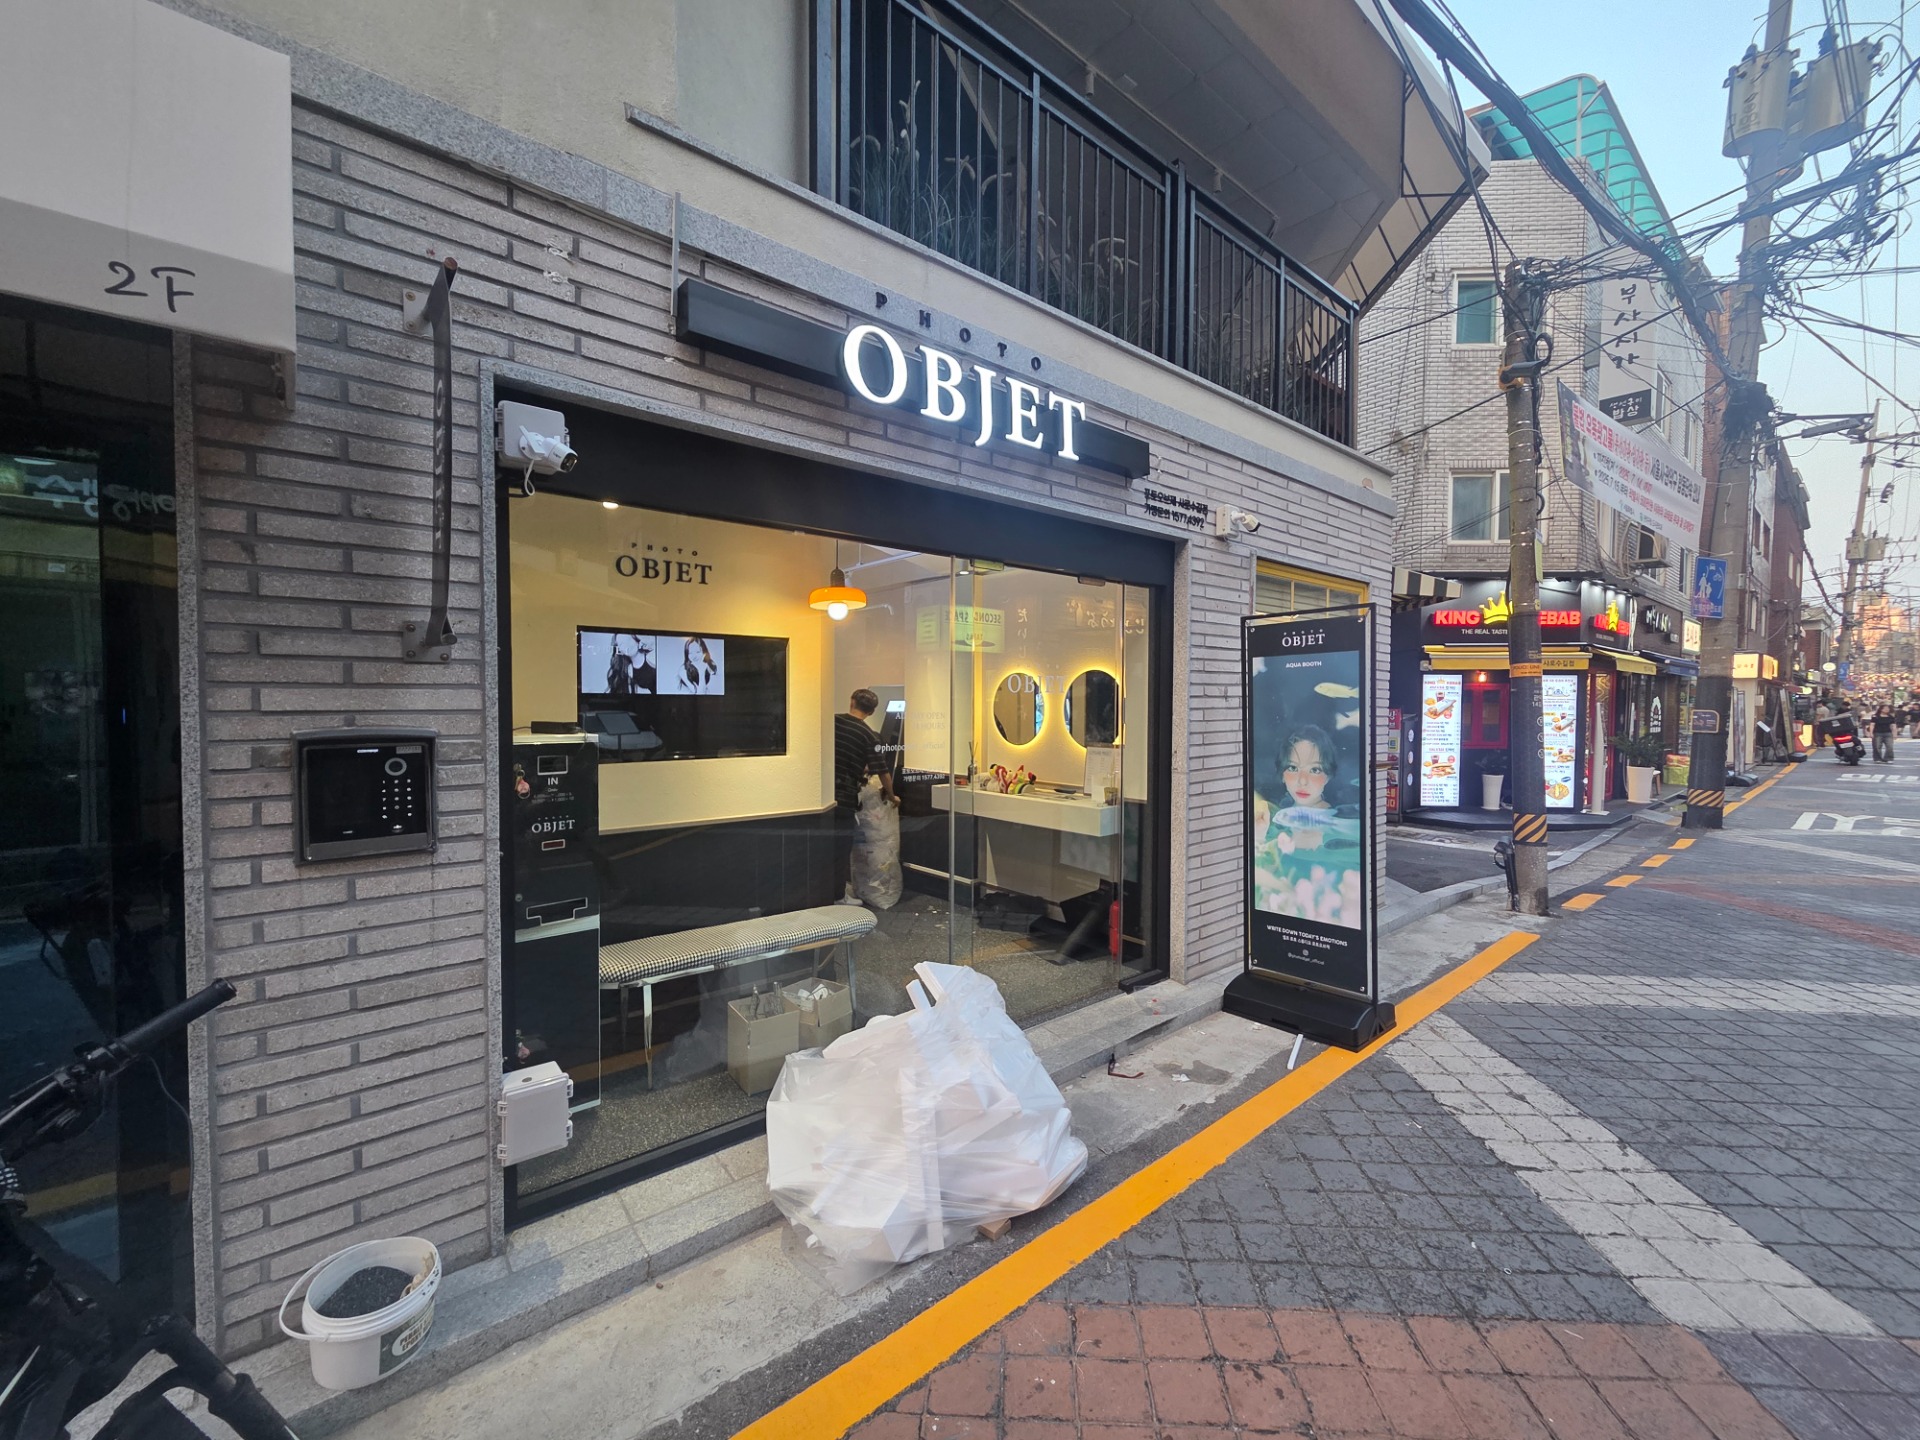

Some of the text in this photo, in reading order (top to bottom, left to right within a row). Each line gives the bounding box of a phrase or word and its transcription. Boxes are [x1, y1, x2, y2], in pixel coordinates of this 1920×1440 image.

[104, 260, 196, 313] 2F
[875, 291, 1042, 371] PHOTO
[843, 323, 1086, 461] OBJET
[1612, 405, 1640, 421] 밥상
[1144, 503, 1170, 519] 가맹문의
[631, 542, 698, 557] PHOTO
[615, 555, 713, 585] OBJET
[1435, 611, 1480, 626] KING
[1538, 610, 1581, 626] EBAB
[1282, 633, 1326, 648] OBJET
[1302, 660, 1322, 668] BOOTH
[547, 777, 559, 786] IN
[531, 819, 576, 834] OBJET
[1281, 927, 1298, 936] DOWN
[1320, 936, 1348, 947] EMOTIONS
